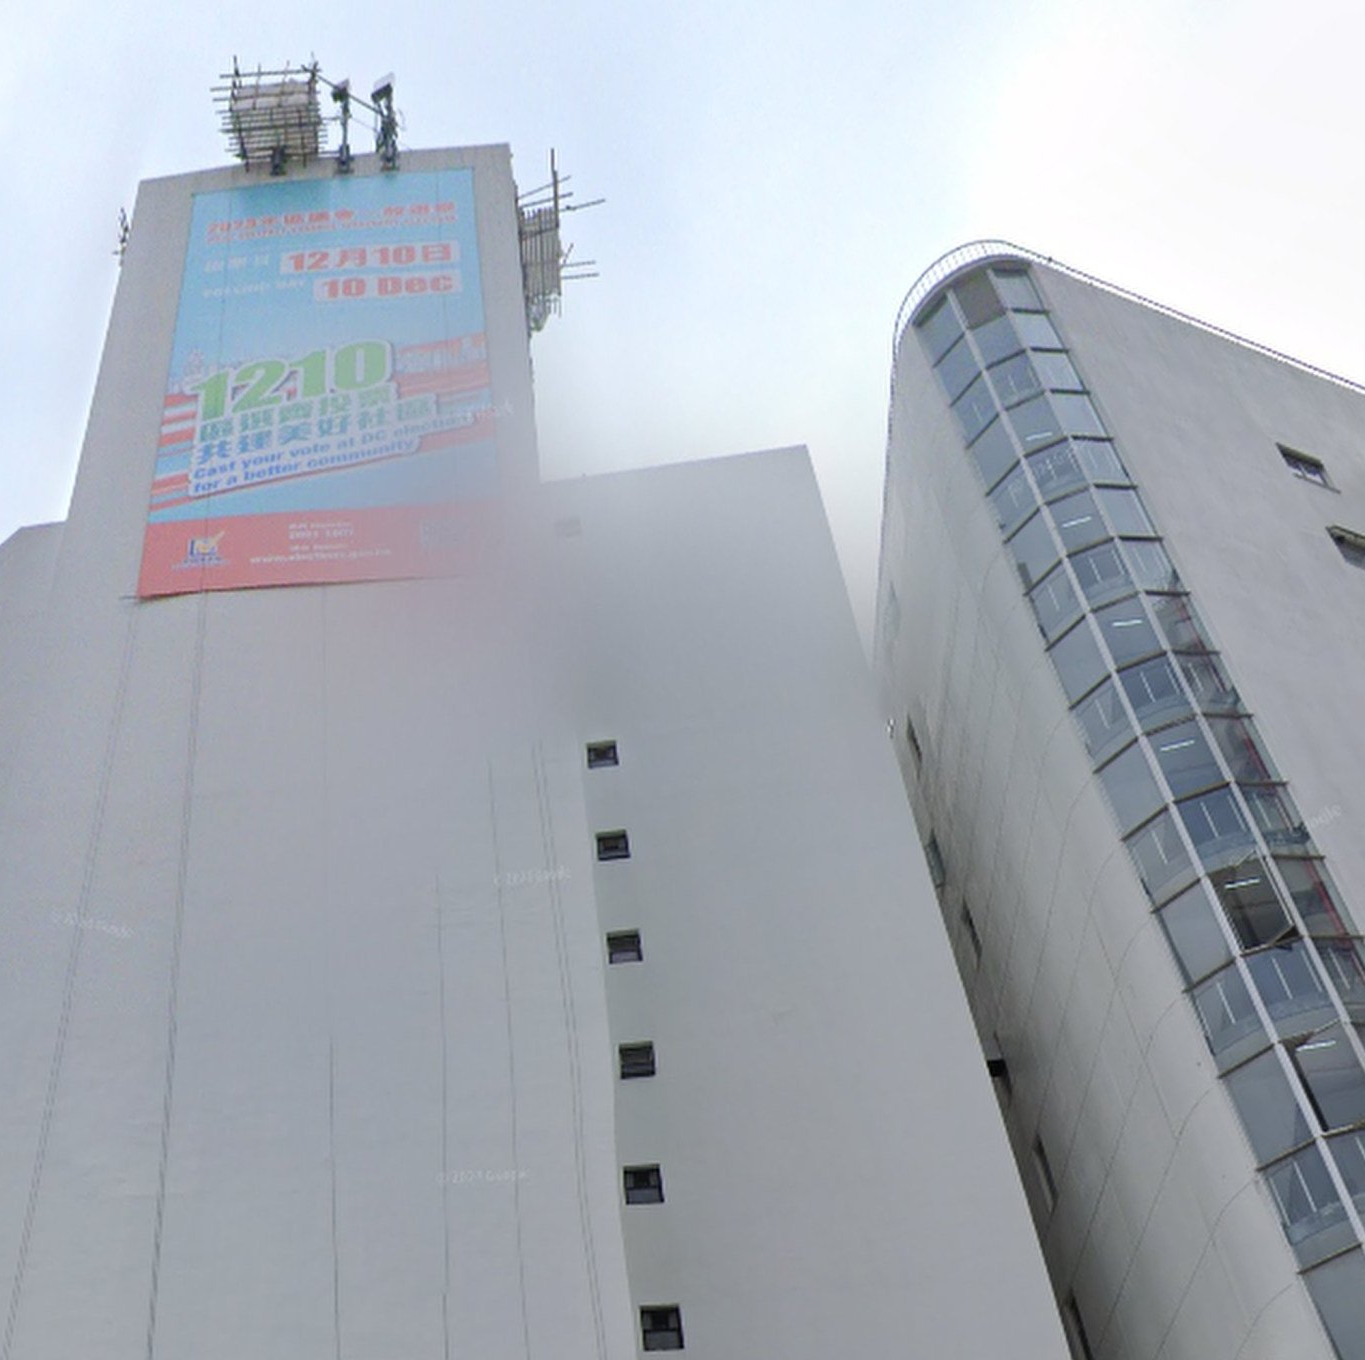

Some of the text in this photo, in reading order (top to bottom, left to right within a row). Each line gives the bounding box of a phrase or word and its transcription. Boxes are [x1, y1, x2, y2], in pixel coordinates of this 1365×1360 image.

[288, 243, 452, 272] 12月10日
[323, 278, 367, 298] 10
[377, 276, 454, 295] Dec
[189, 339, 392, 421] 1210
[241, 453, 283, 471] your
[290, 442, 331, 459] vote
